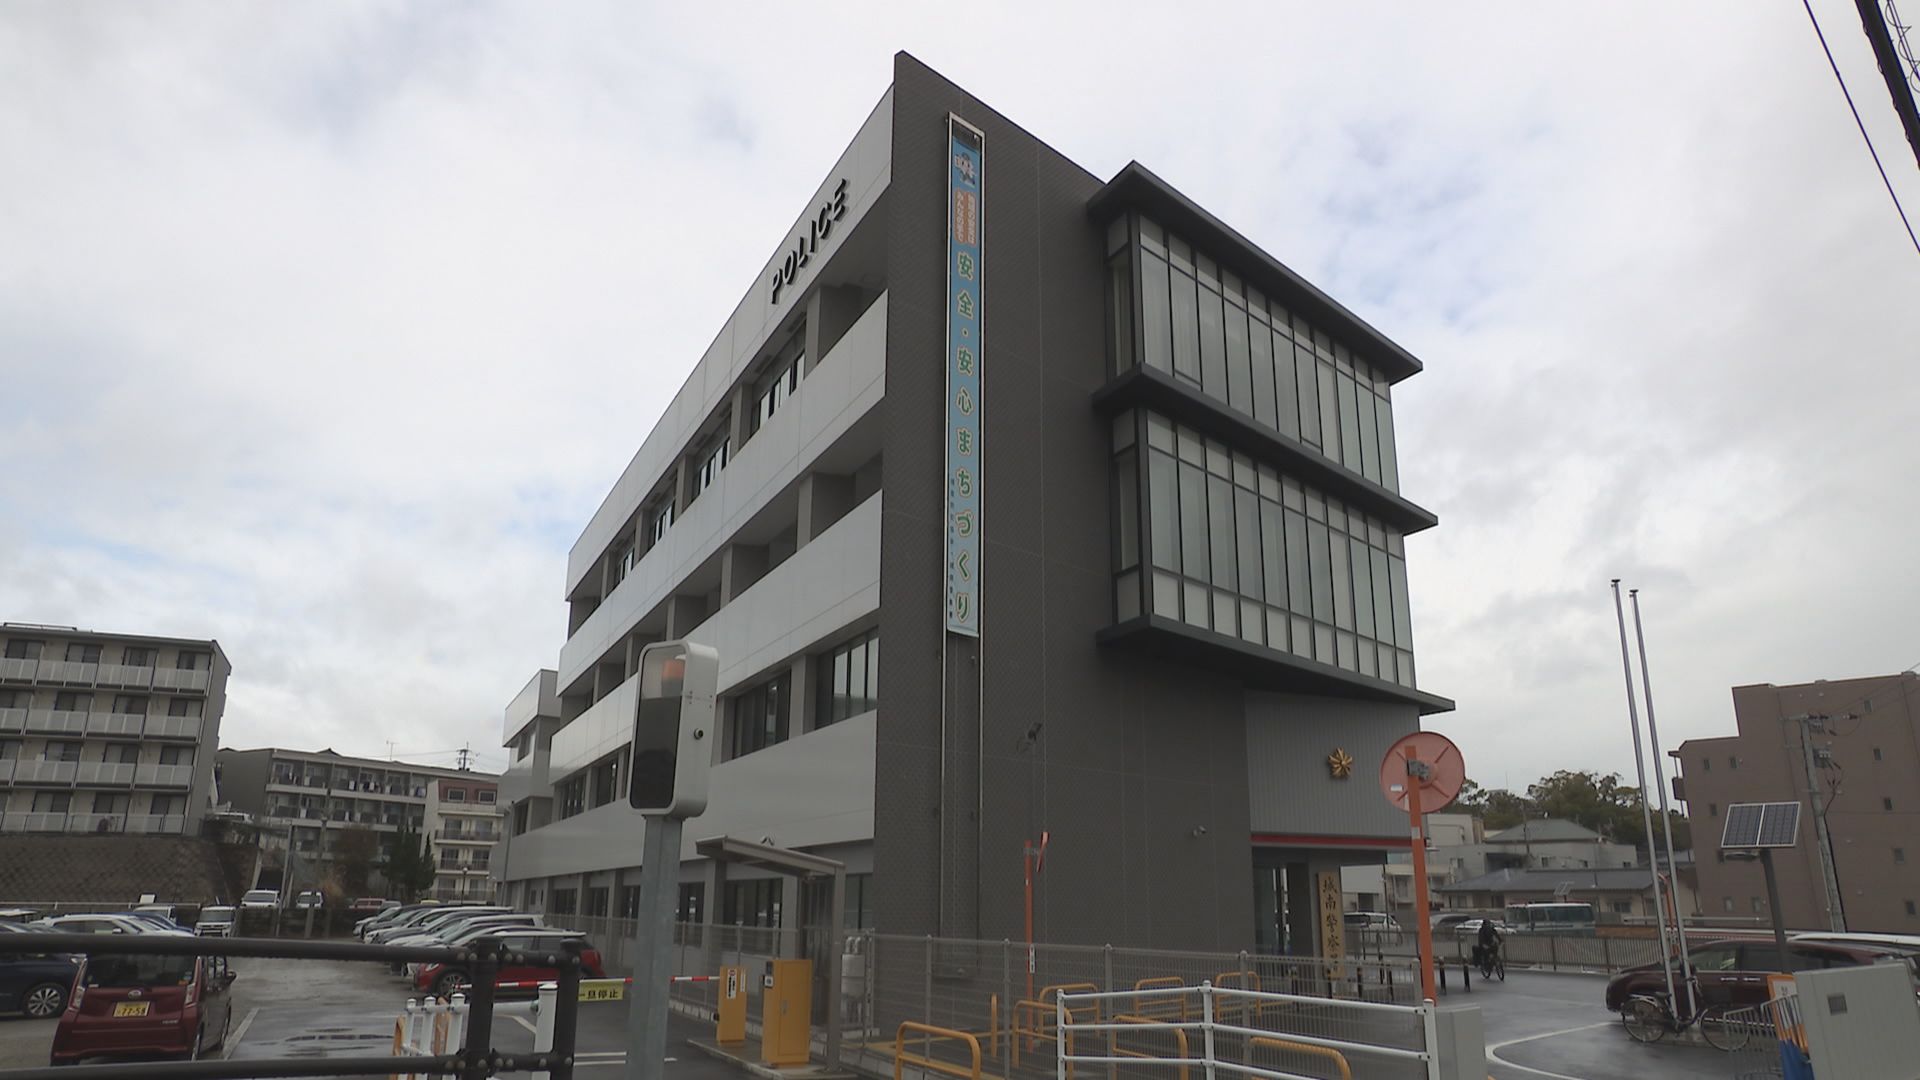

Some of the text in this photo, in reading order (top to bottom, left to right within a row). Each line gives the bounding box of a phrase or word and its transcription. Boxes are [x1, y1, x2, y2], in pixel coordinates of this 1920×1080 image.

[771, 178, 847, 304] POLICE
[956, 252, 974, 623] 安全・安心まちづくり
